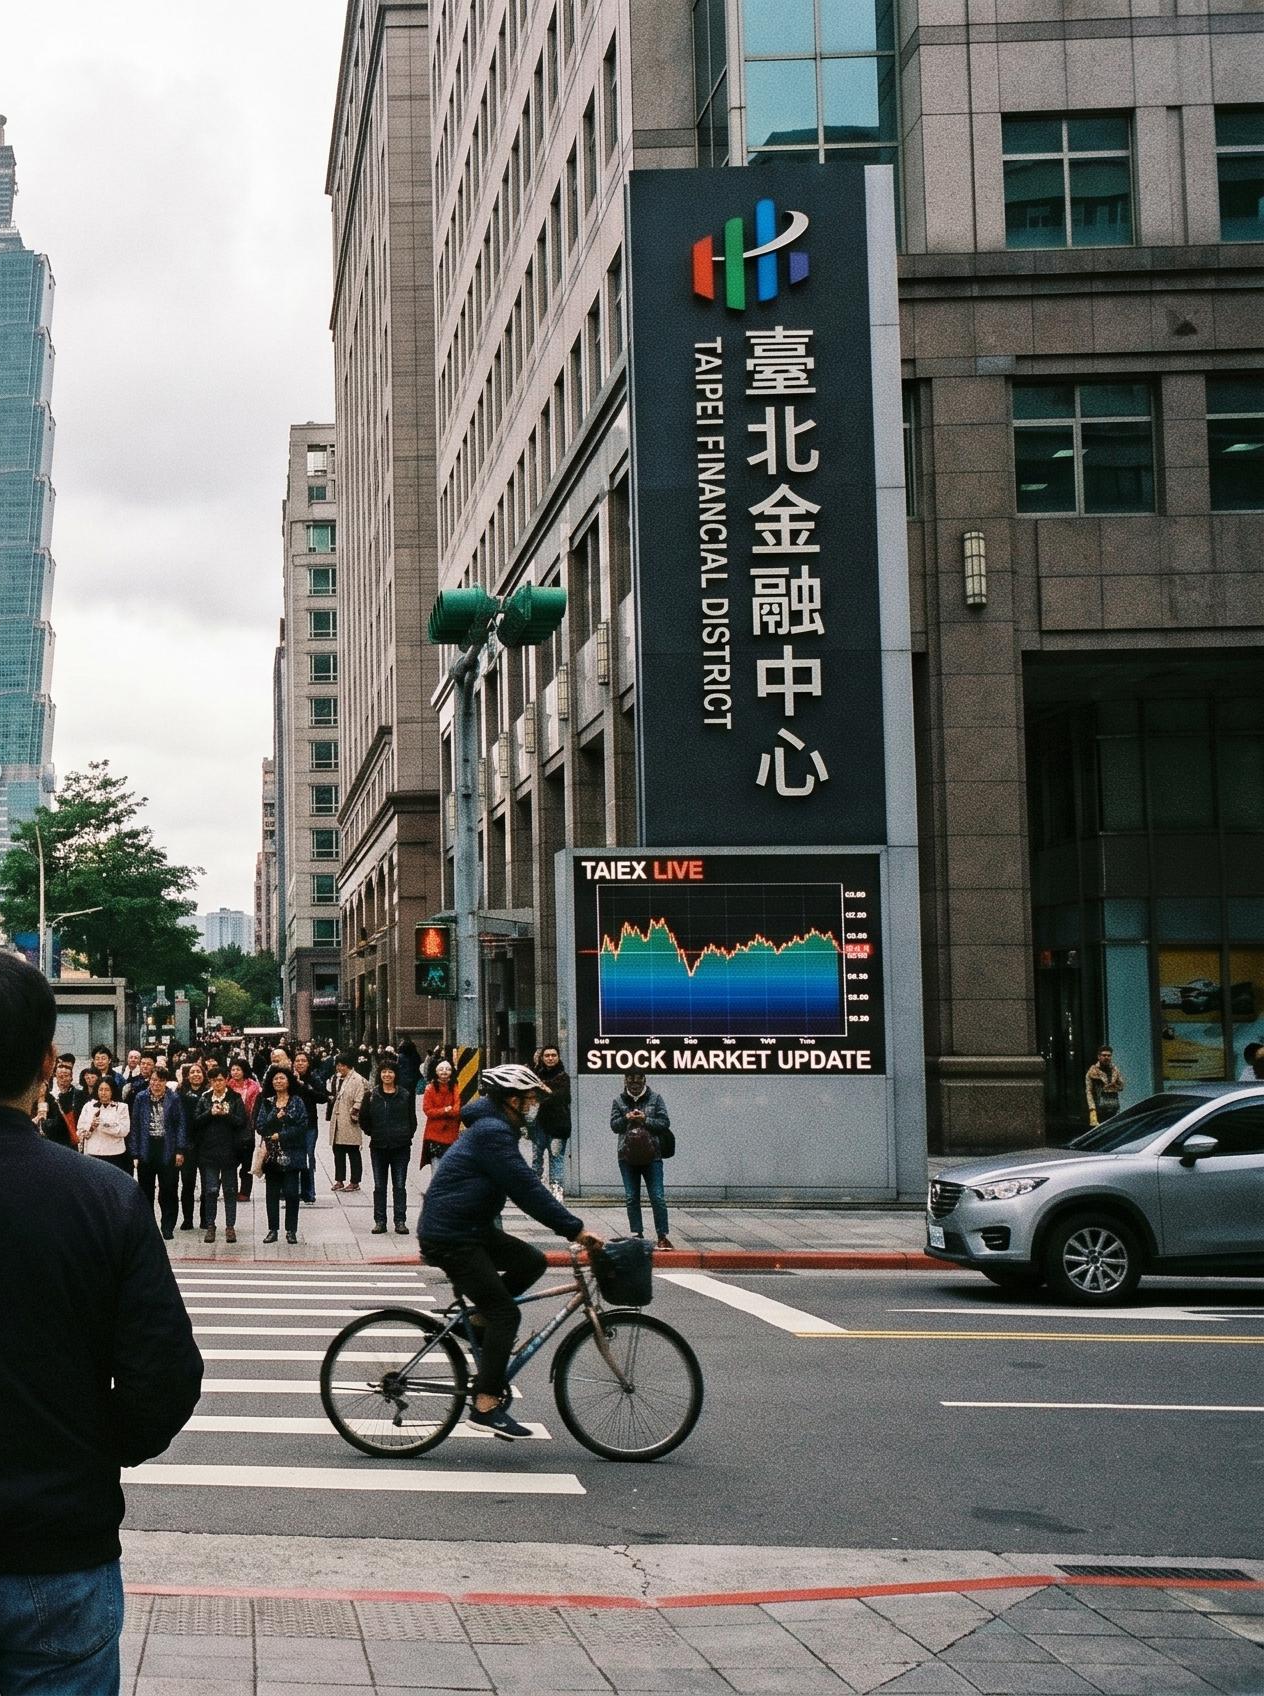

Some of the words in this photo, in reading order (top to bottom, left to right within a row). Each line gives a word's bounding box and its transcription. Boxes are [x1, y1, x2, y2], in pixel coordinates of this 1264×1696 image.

[693, 336, 725, 425] TAIPEI
[696, 436, 728, 589] FINANCIAL
[745, 325, 829, 797] 臺北金融中心
[701, 598, 732, 730] DISTRICT
[581, 860, 647, 880] TAIEX
[653, 860, 704, 880] LIVE
[586, 1049, 667, 1069] STOCK
[673, 1050, 772, 1069] MARKET
[777, 1050, 872, 1070] UPDATE
